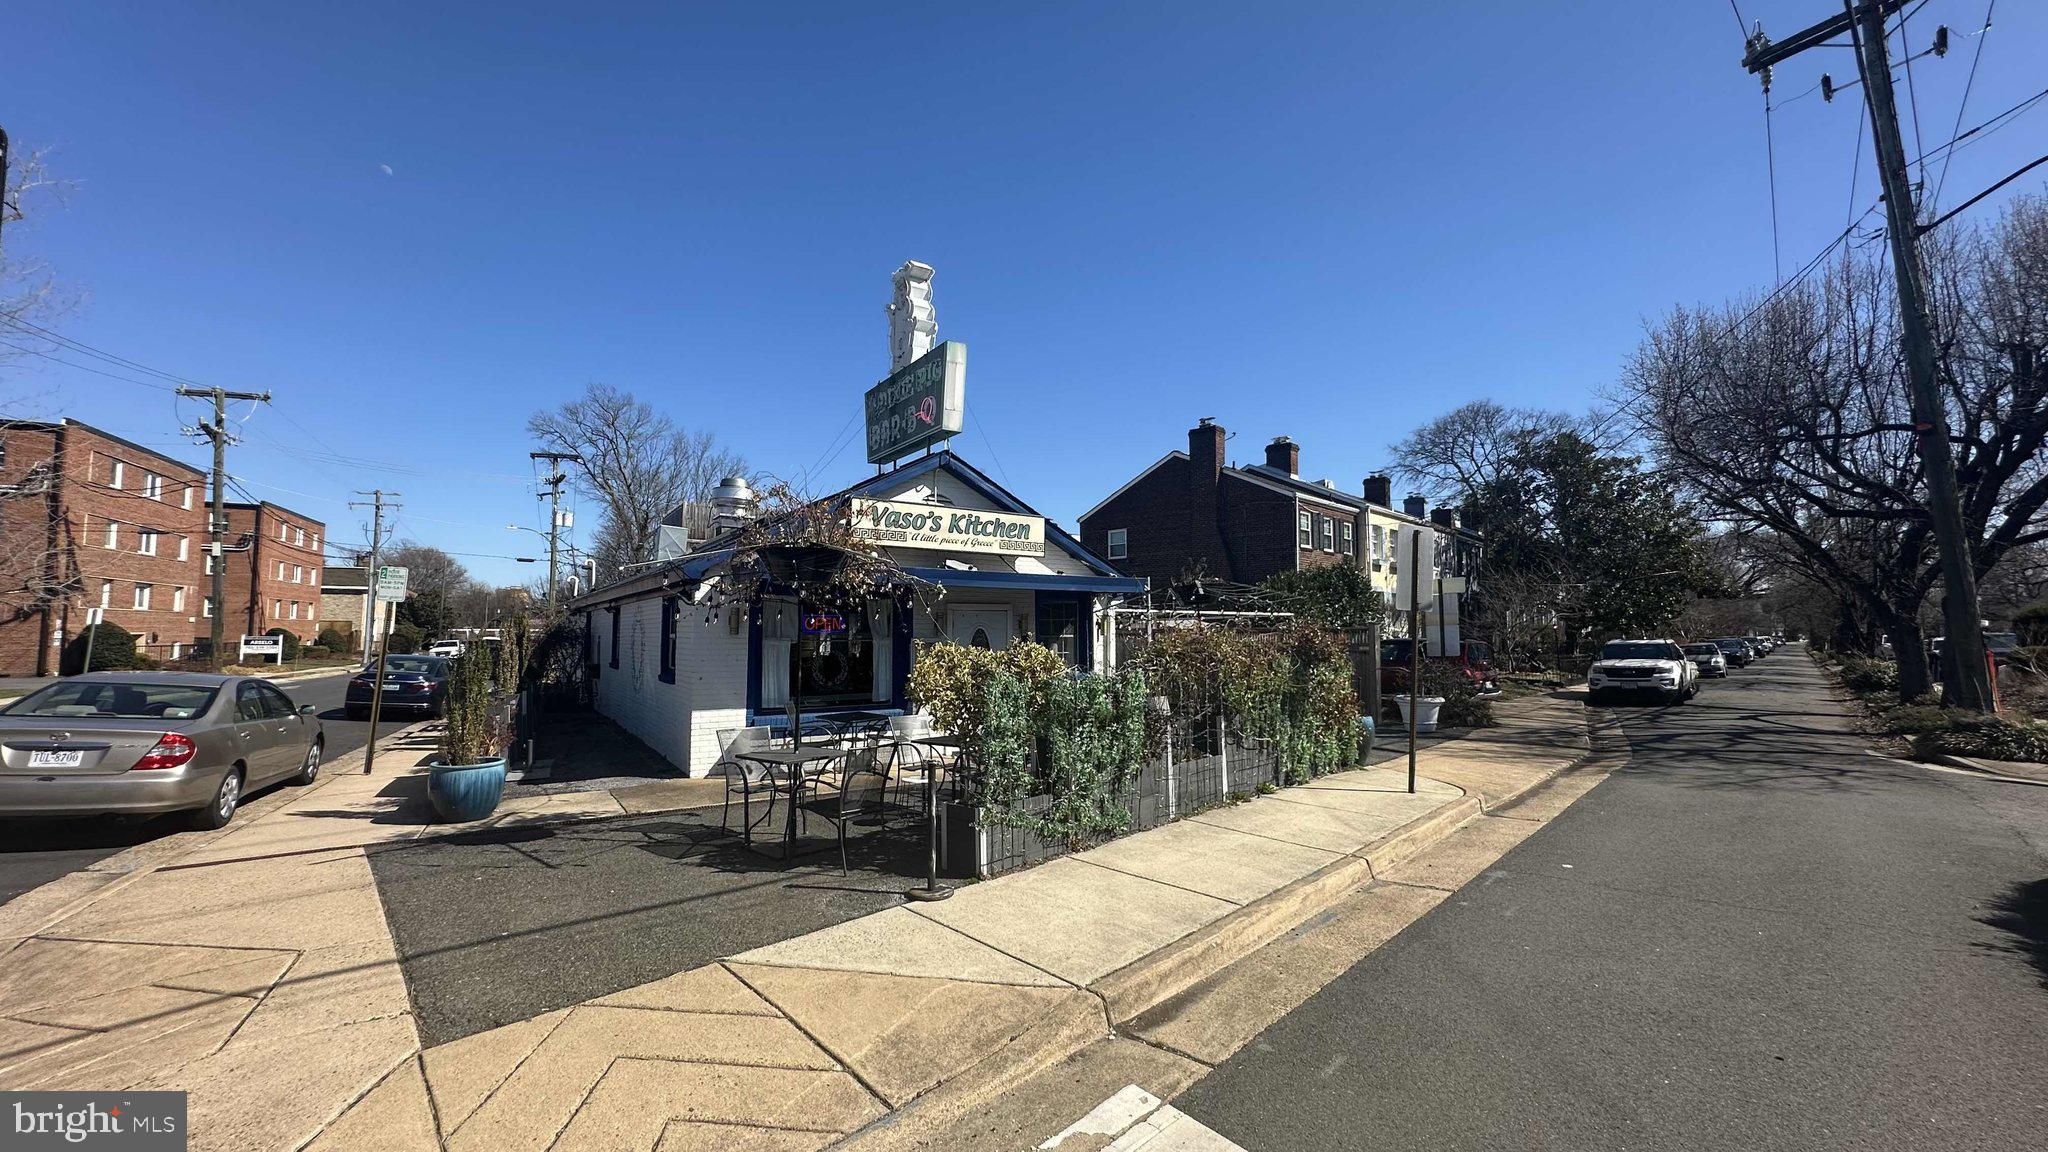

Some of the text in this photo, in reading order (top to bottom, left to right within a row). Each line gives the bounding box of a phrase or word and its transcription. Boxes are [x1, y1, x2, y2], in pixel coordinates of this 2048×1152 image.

[872, 505, 1031, 540] Vaso's Kitchen
[919, 533, 939, 543] little
[939, 537, 959, 546] piece
[960, 537, 969, 548] of
[381, 569, 387, 578] 2
[805, 617, 841, 631] OPEN
